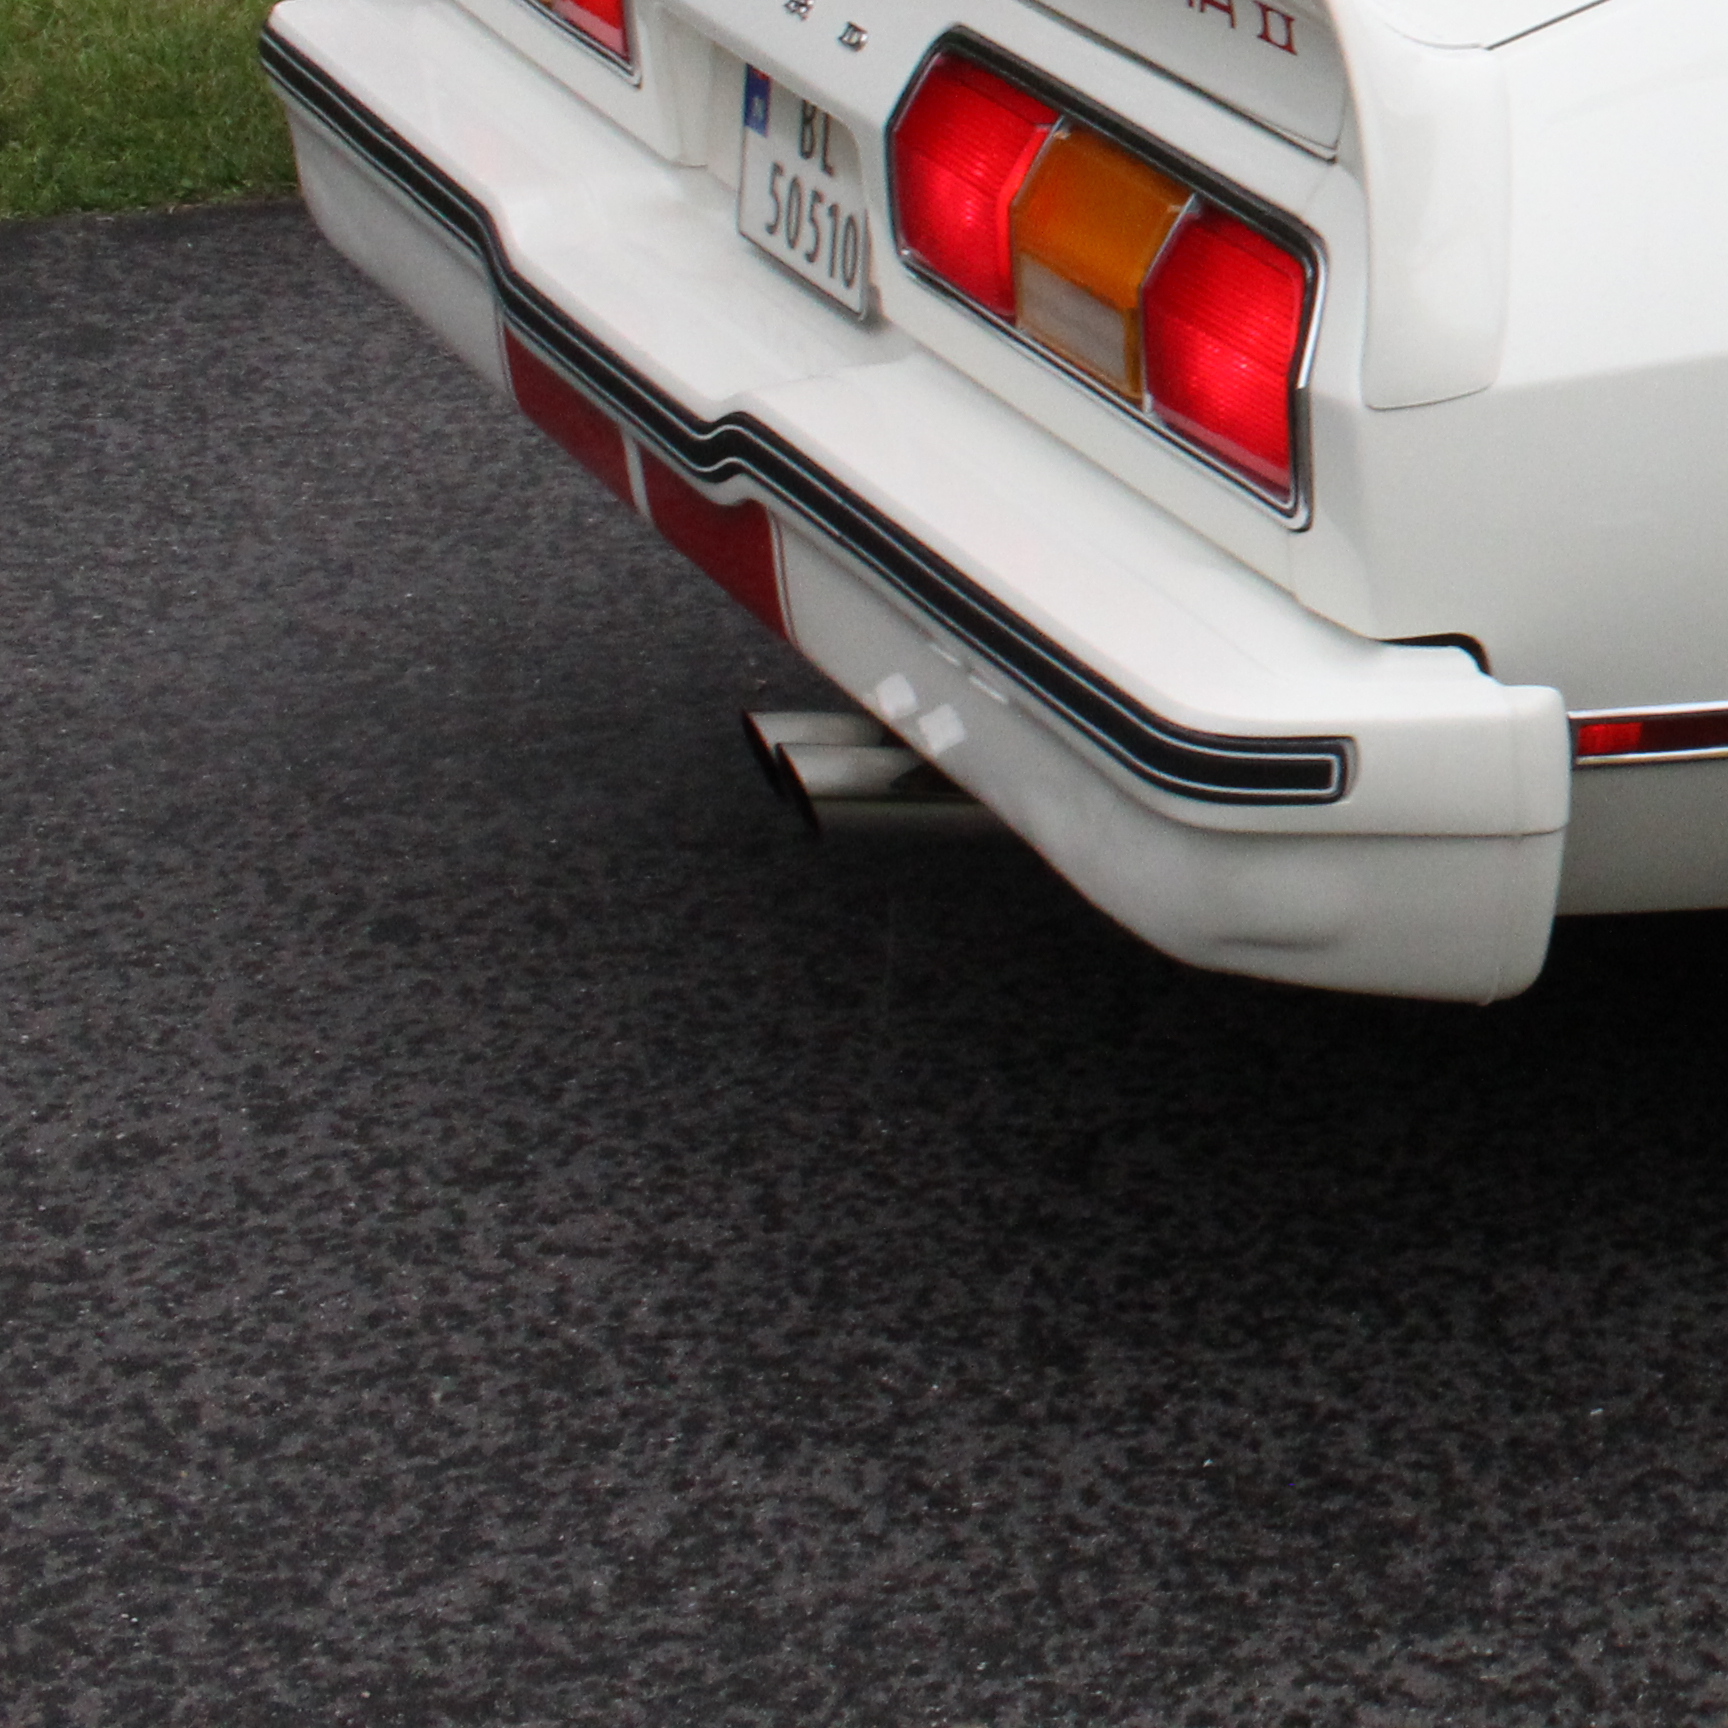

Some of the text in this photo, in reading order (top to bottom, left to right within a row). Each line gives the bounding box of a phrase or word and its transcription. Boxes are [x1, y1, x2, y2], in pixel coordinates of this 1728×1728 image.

[1252, 0, 1298, 55] II
[799, 98, 835, 176] BL
[765, 161, 859, 289] 50510
